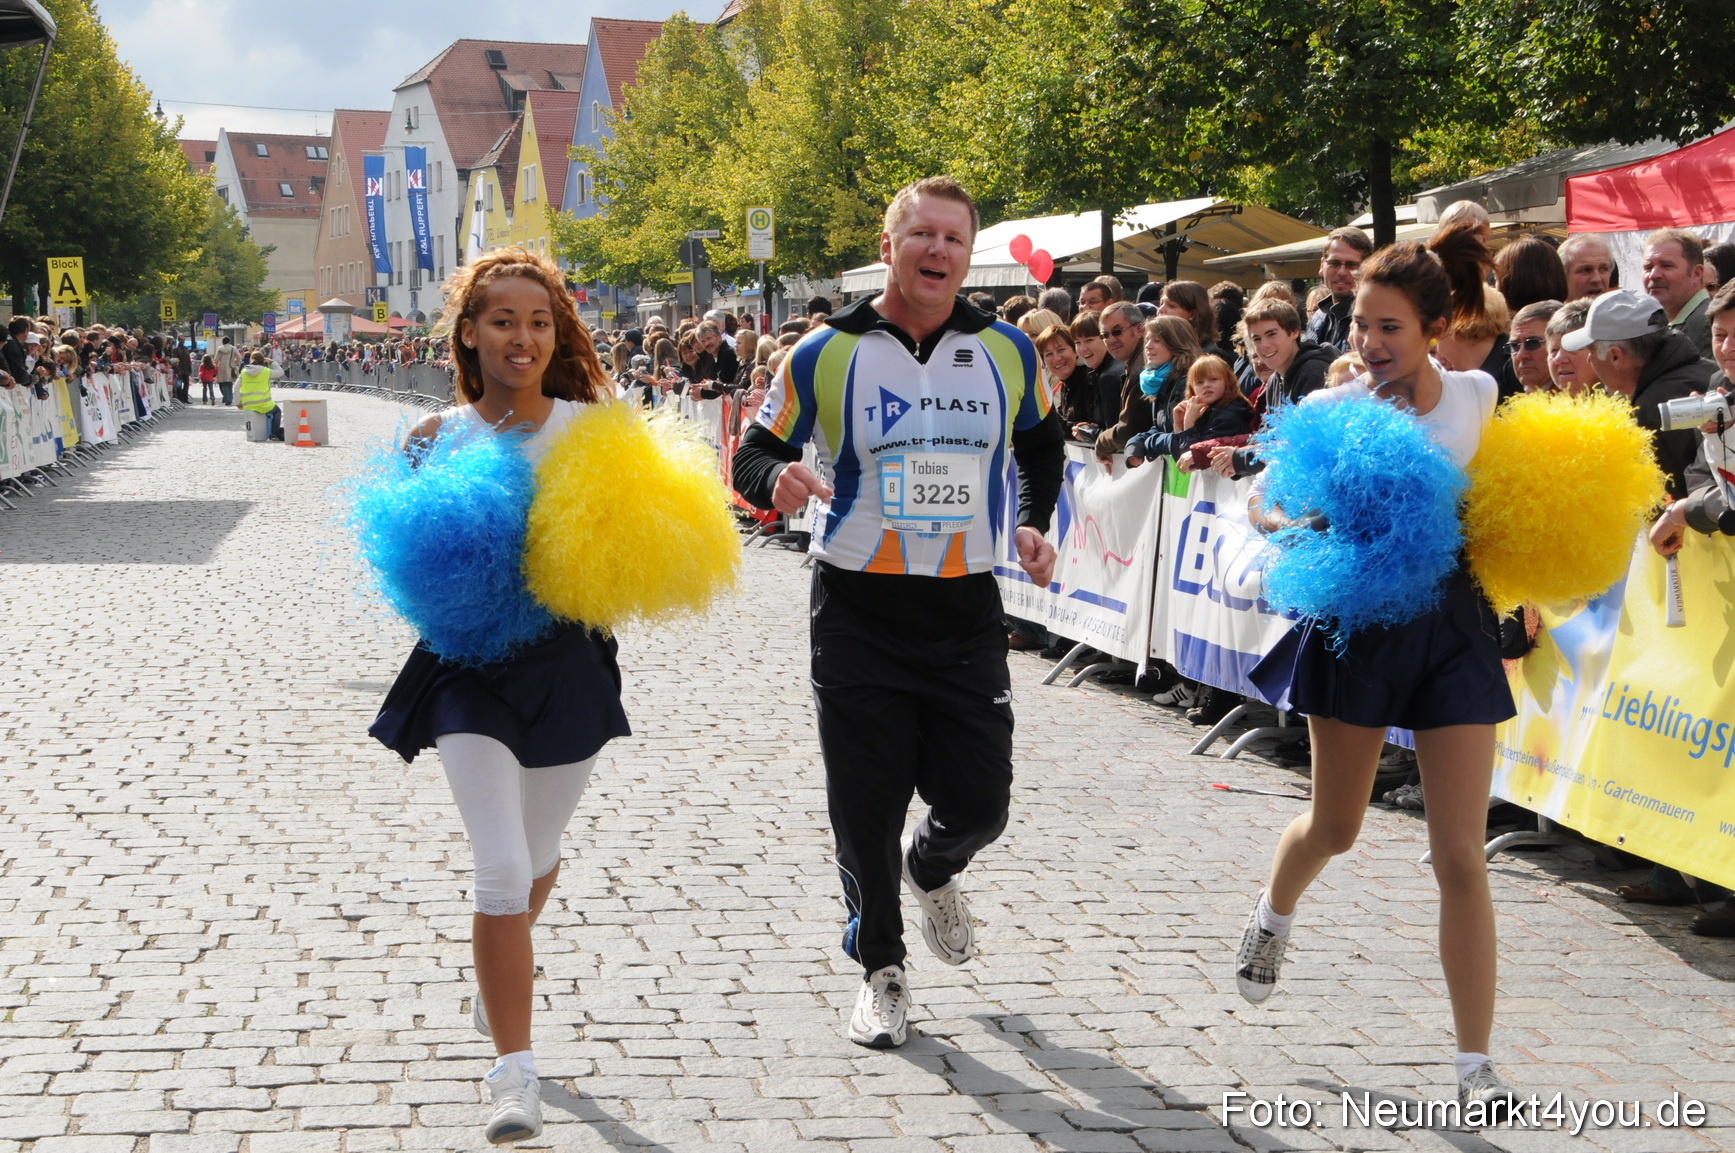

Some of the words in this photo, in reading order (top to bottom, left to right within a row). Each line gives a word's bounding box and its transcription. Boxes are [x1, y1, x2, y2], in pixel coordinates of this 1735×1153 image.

[416, 192, 426, 236] RUPPERT
[755, 214, 765, 226] H
[51, 259, 79, 269] Block
[58, 272, 78, 296] A
[164, 306, 173, 317] B
[378, 309, 385, 319] B
[920, 397, 990, 415] PLAST
[869, 436, 989, 455] www.tr-plast.de
[911, 460, 948, 475] Tobias
[889, 482, 895, 493] B
[912, 483, 970, 505] 3225
[1603, 780, 1695, 823] Gartenmauern
